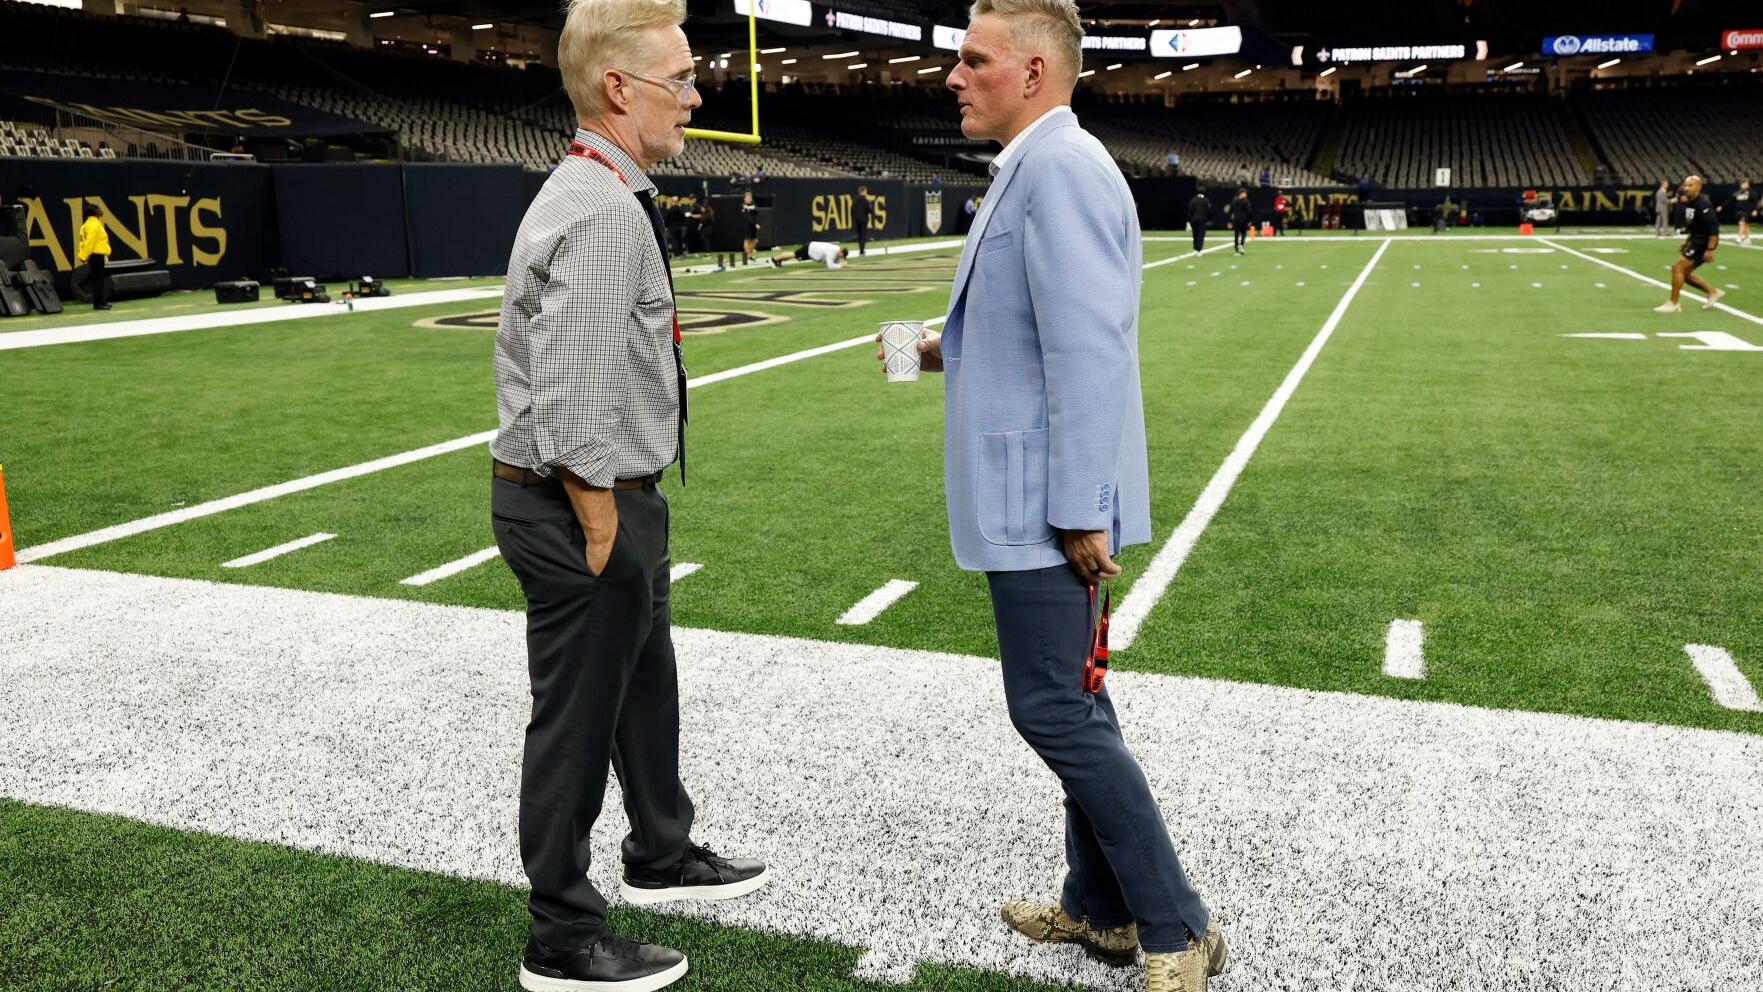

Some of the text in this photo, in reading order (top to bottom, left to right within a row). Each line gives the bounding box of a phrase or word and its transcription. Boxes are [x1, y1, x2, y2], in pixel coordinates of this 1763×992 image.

[1331, 44, 1465, 61] PATRON SAINTS PARTNERS
[1580, 37, 1639, 53] Allstate
[0, 194, 228, 272] AINTS
